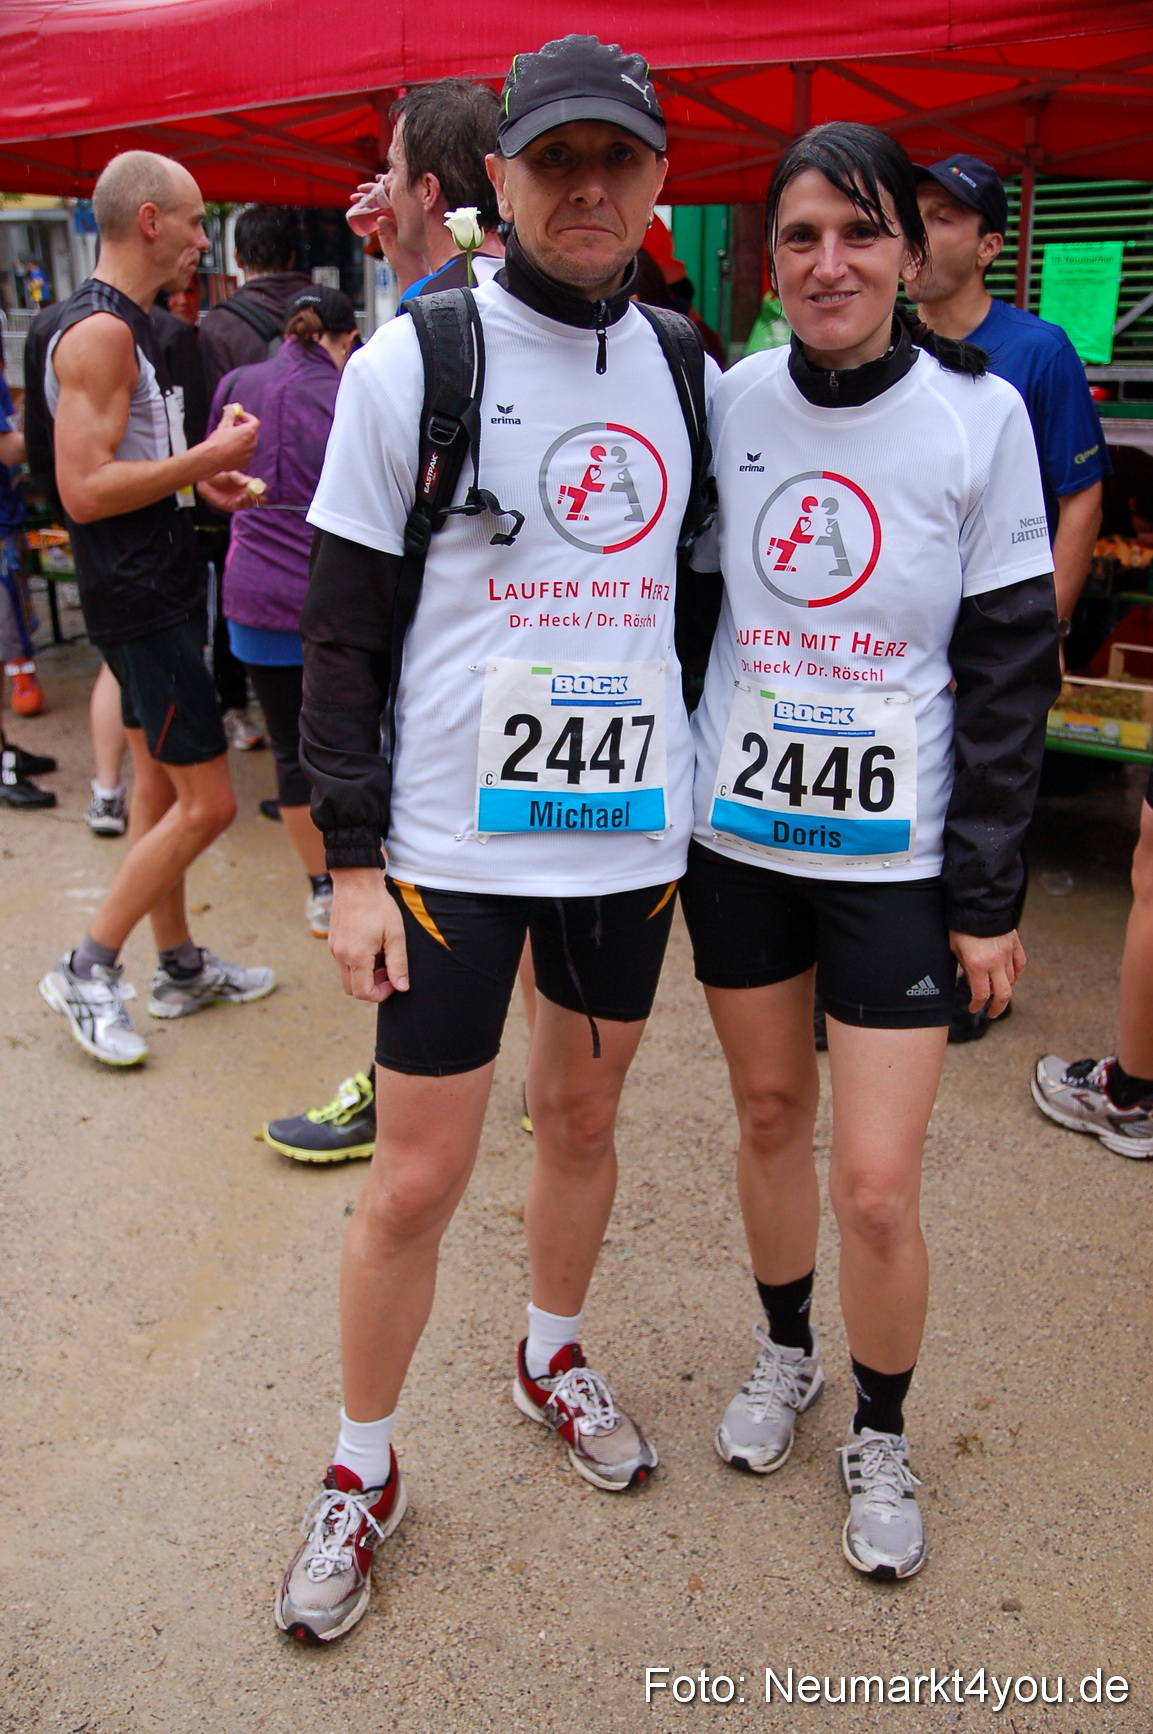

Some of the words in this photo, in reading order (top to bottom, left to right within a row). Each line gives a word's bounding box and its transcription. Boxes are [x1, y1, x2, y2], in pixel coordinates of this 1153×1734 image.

[490, 416, 522, 426] erima
[423, 452, 439, 494] EASTPAK
[738, 462, 765, 473] erima
[488, 577, 580, 601] LAUFEN
[591, 580, 631, 598] MIT
[640, 576, 671, 601] HERZ
[509, 613, 533, 628] Dr.
[538, 612, 581, 628] Heck
[585, 611, 593, 629] /
[597, 611, 618, 628] Dr.
[623, 612, 656, 629] Röschl
[800, 631, 841, 651] MIT
[851, 630, 909, 658] HERZ
[753, 660, 791, 675] Heck
[794, 660, 803, 677] /
[806, 662, 828, 678] Dr.
[832, 664, 884, 682] Röschl
[551, 674, 629, 695] BOCK
[773, 700, 855, 726] BOCK
[500, 713, 656, 785] 2447
[485, 773, 494, 786] C
[731, 731, 897, 814] 2446
[719, 784, 727, 798] C
[529, 800, 630, 829] Michael
[773, 820, 842, 849] Doris
[906, 988, 939, 996] adidas
